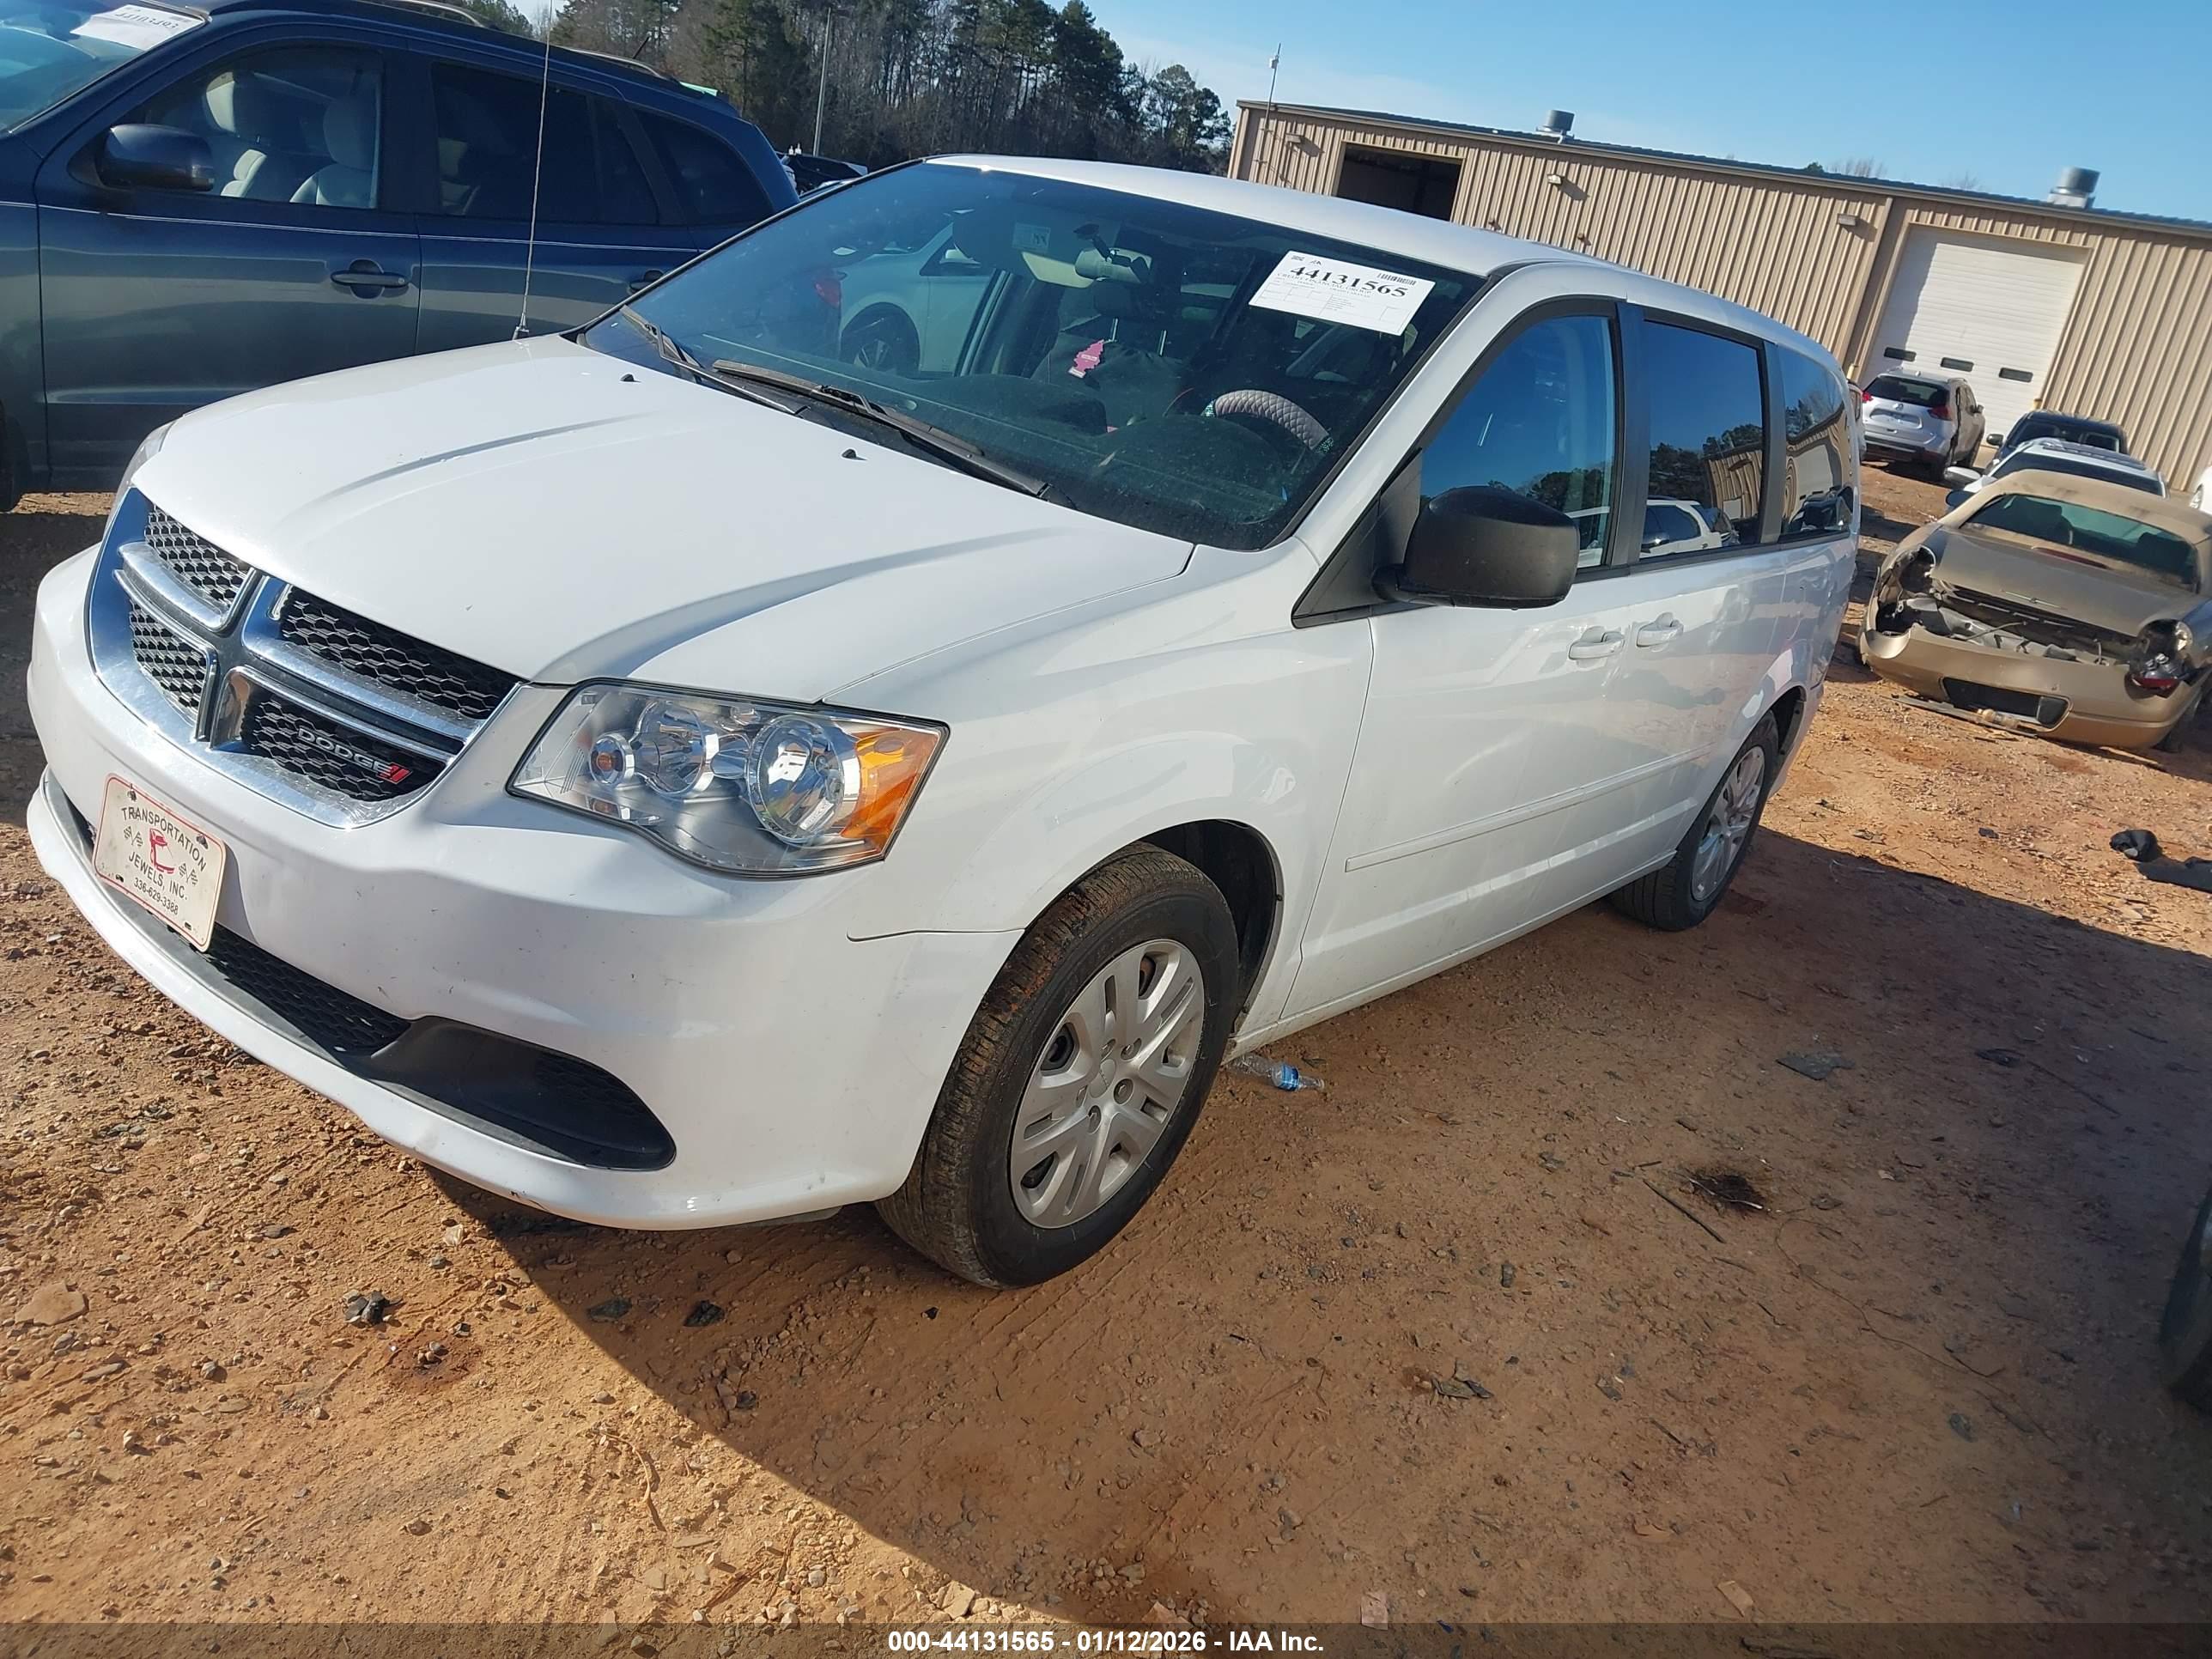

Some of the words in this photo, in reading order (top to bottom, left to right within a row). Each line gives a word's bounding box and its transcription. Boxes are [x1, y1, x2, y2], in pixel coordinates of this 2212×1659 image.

[1290, 266, 1409, 297] 44131565
[298, 727, 392, 776] DODGE
[121, 806, 207, 872] TRANSPORTATION
[129, 851, 165, 891] JEWELS,
[169, 879, 187, 901] INC.
[134, 877, 179, 915] 336-629-3388
